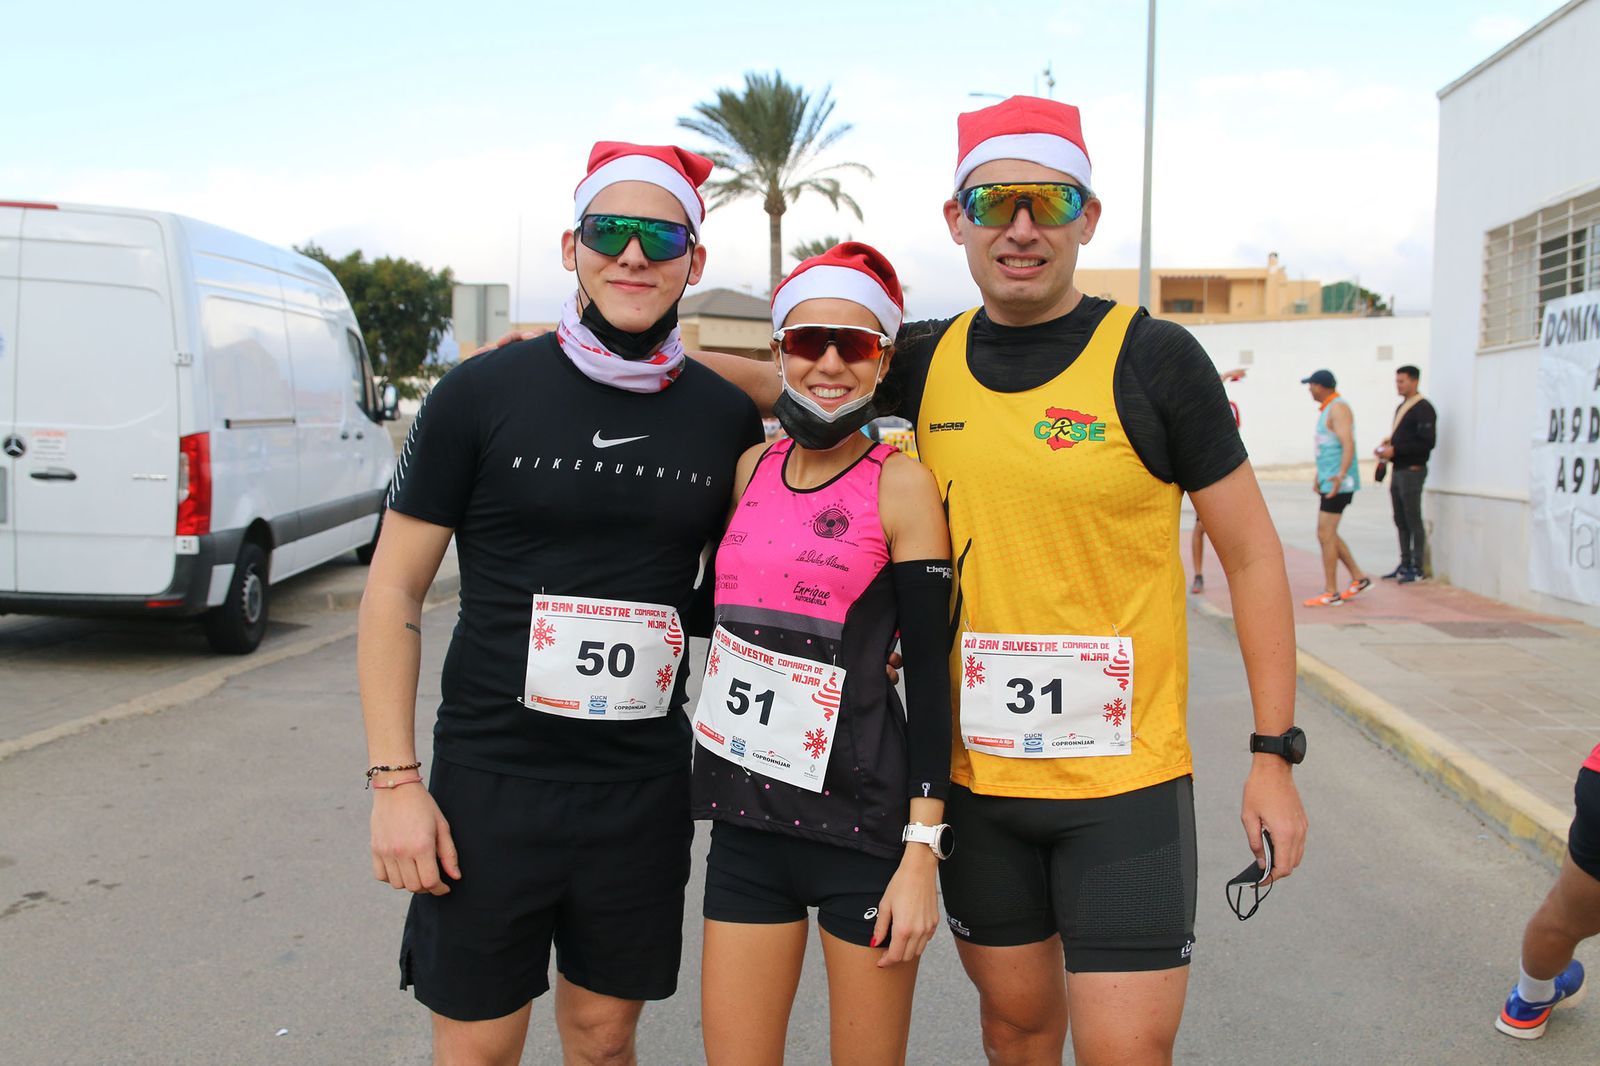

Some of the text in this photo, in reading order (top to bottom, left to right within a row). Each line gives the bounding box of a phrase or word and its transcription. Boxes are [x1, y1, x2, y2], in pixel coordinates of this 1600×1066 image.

[1571, 406, 1582, 443] 9
[1555, 456, 1566, 493] A
[1573, 457, 1585, 494] 9
[793, 581, 831, 599] Enrique
[551, 602, 573, 613] SAN
[576, 603, 631, 618] SILVESTRE
[635, 608, 660, 617] COMARCA
[661, 610, 667, 618] DE
[575, 640, 635, 678] 50
[732, 641, 775, 666] SILVESTRE
[778, 658, 812, 673] COMARCA
[814, 666, 823, 675] DE
[978, 639, 999, 650] SAN
[1002, 640, 1058, 652] SILVESTRE
[1062, 641, 1098, 650] COMARCA
[1101, 642, 1110, 650] DE
[726, 677, 775, 726] 51
[1006, 677, 1062, 714] 31
